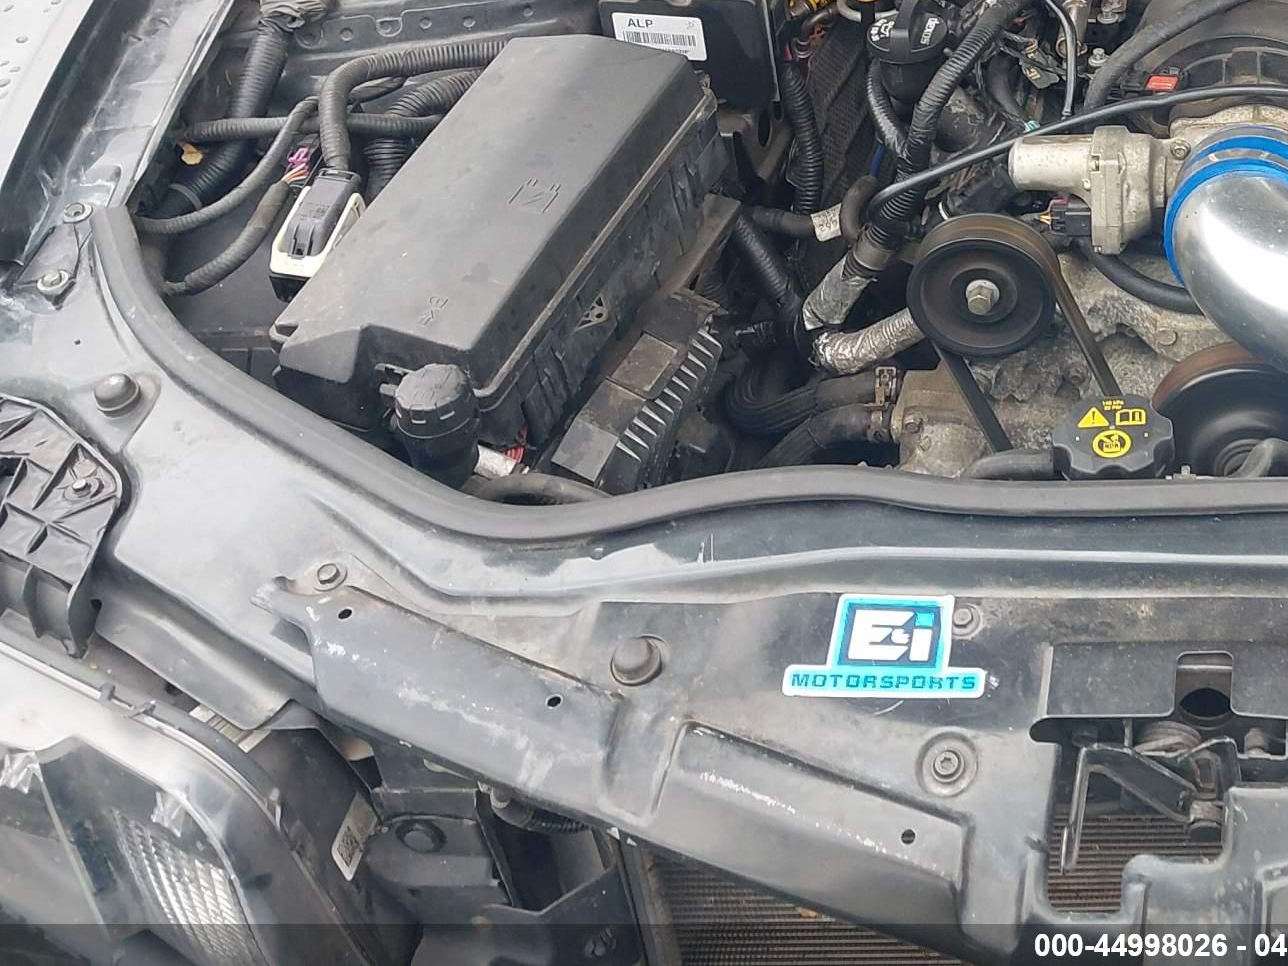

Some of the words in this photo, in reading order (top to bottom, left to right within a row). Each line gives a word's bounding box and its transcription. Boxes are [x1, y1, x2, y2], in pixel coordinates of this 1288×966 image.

[627, 17, 654, 28] ALP
[920, 17, 940, 46] dexos
[790, 673, 976, 690] MOTORSPORTS
